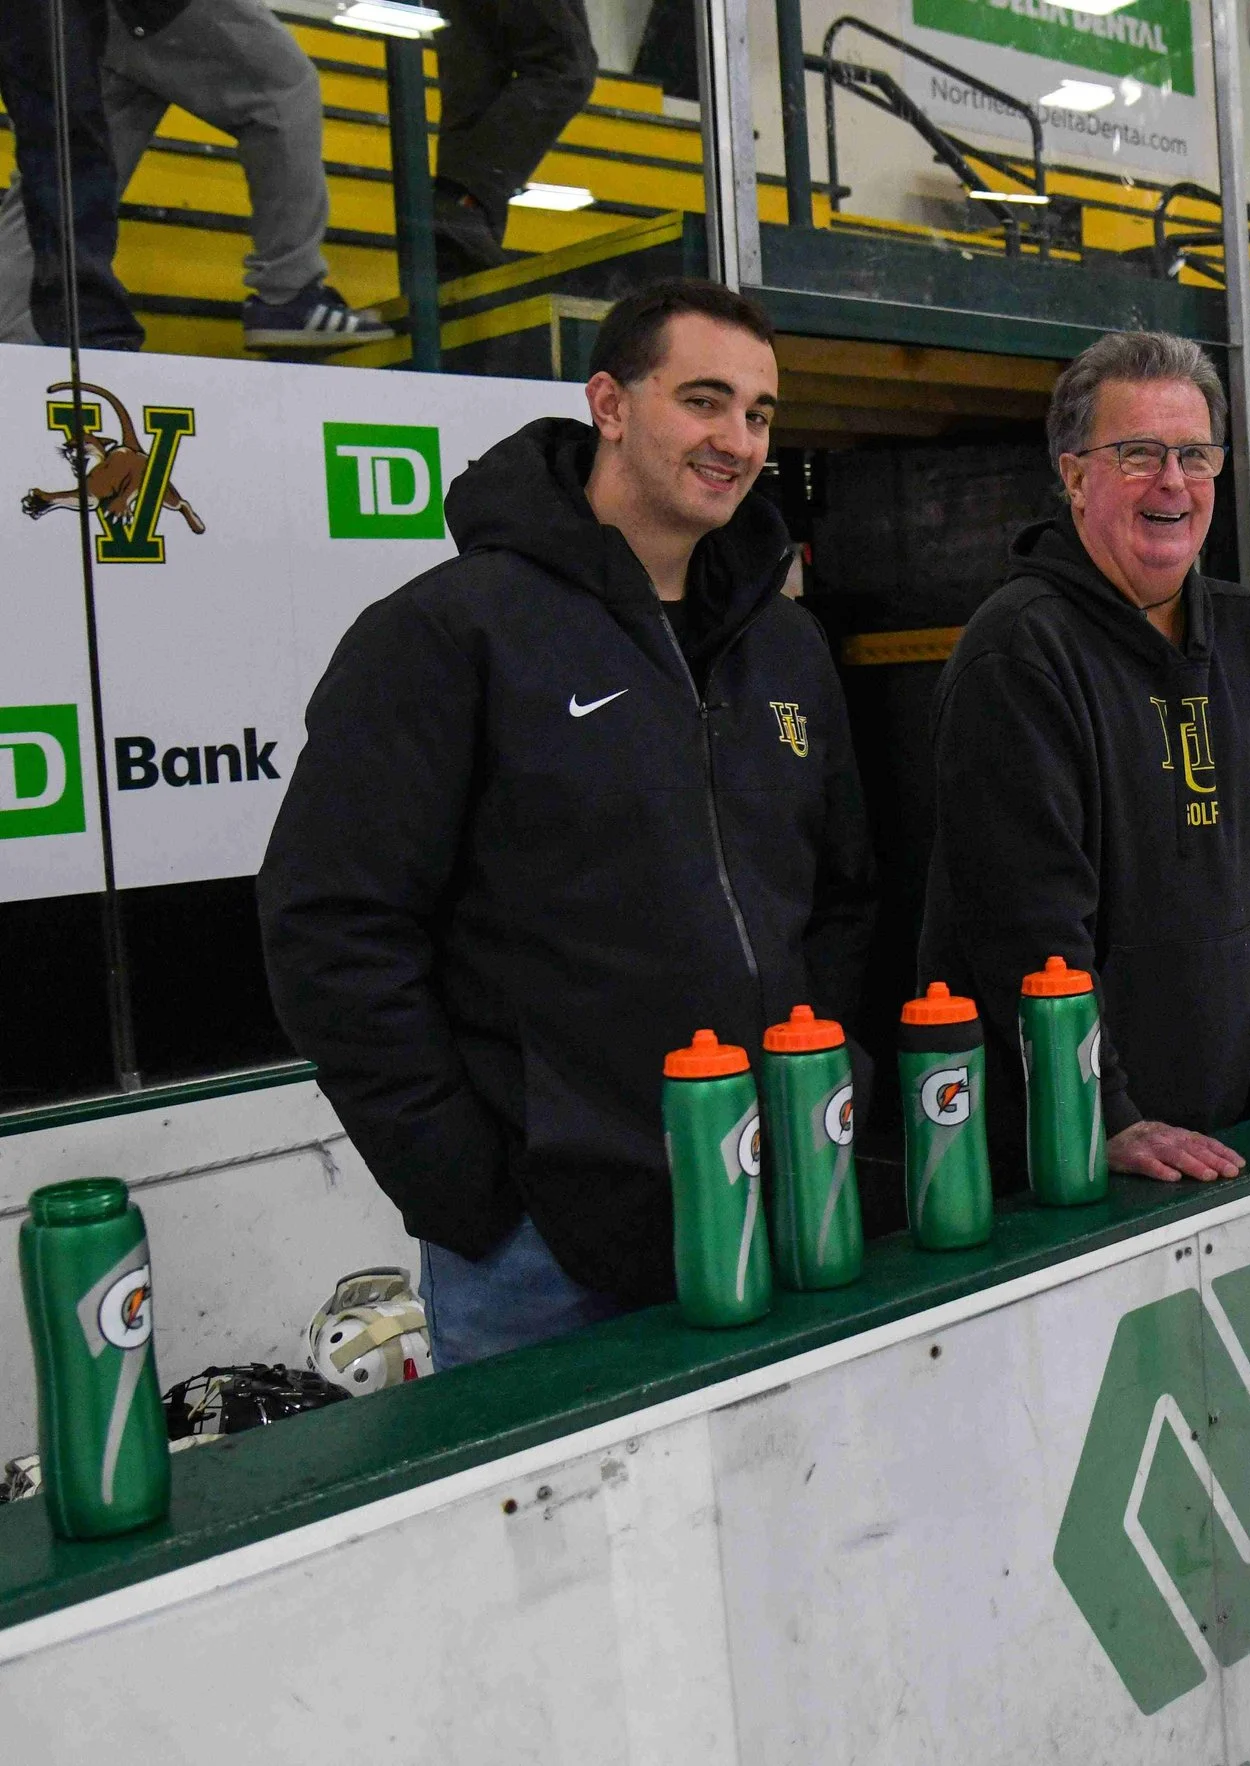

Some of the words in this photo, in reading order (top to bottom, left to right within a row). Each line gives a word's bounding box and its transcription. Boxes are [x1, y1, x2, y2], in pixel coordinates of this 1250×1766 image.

[336, 446, 430, 516] TD
[769, 701, 809, 758] HU
[0, 731, 67, 811] D
[114, 727, 281, 791] Bank
